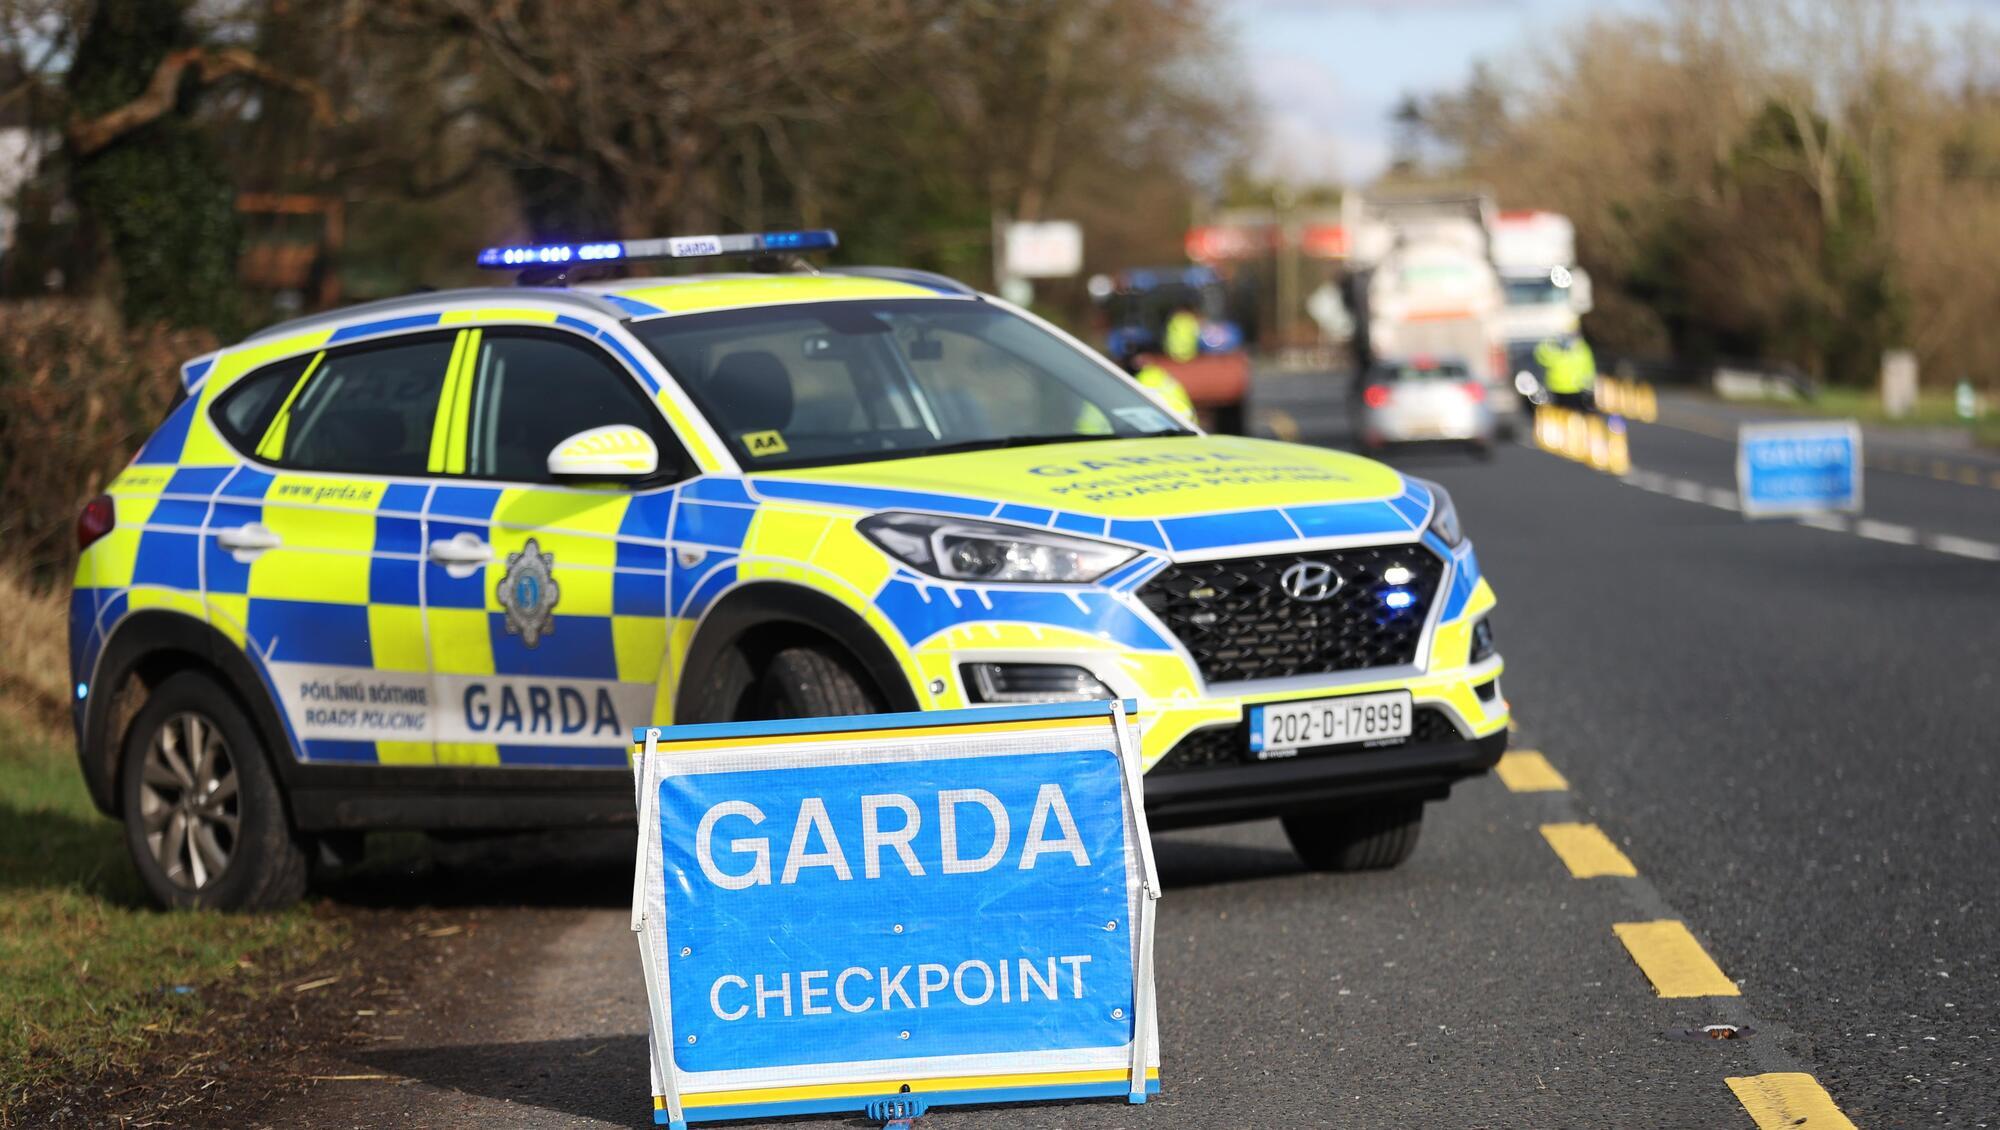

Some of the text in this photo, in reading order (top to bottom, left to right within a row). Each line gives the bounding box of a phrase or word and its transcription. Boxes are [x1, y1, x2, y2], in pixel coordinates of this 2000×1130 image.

[754, 436, 779, 449] AA
[1028, 453, 1250, 477] GARDA
[278, 484, 372, 502] www.garda.ie
[305, 709, 425, 731] ROADS POLICING
[463, 684, 622, 737] GARDA
[1272, 703, 1403, 744] 202-D-17899
[695, 783, 1092, 890] GARDA
[710, 955, 1092, 1021] CHECKPOINT
